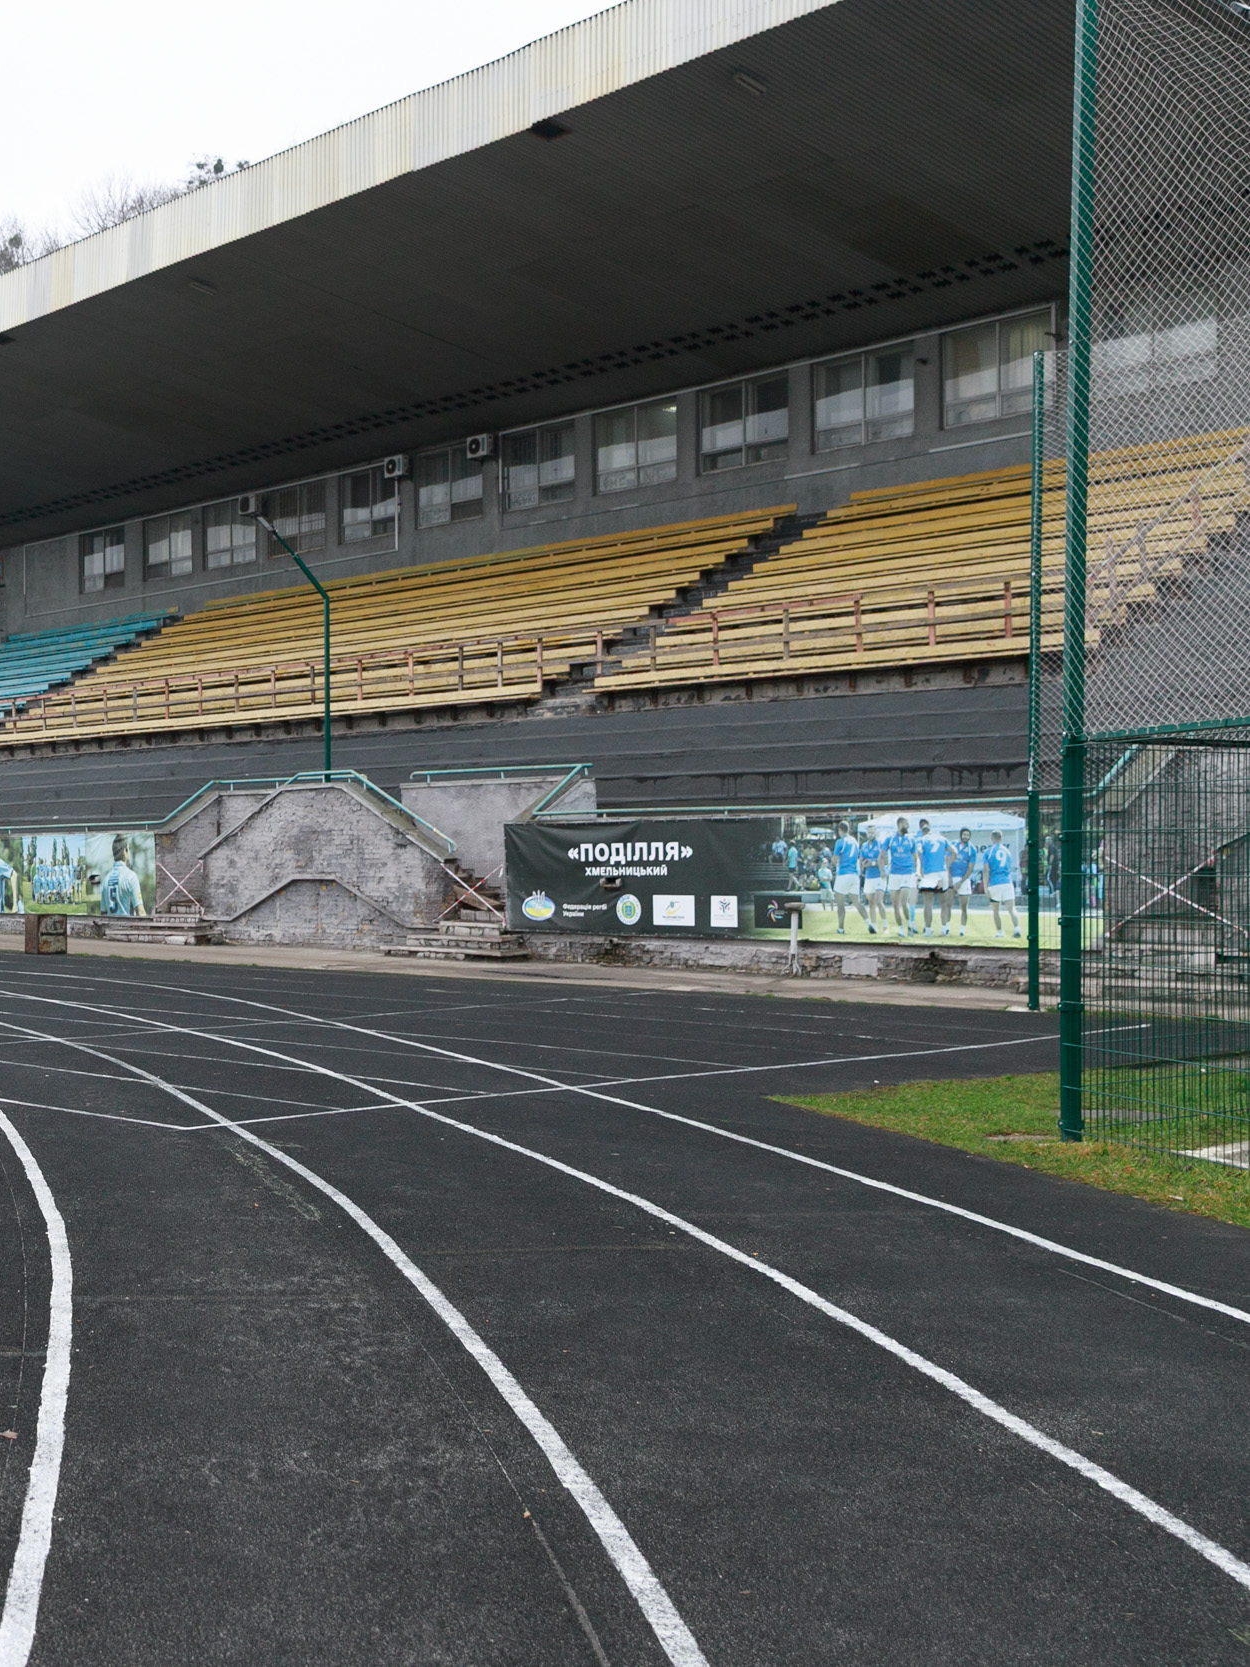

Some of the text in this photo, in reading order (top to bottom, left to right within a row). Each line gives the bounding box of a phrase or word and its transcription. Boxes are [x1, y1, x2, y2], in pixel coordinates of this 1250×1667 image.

[567, 841, 693, 865] «ПОДІЛЛЯ»
[995, 849, 1007, 868] 9
[585, 865, 668, 877] ХМЕЛЬНИЦЬКИЙ
